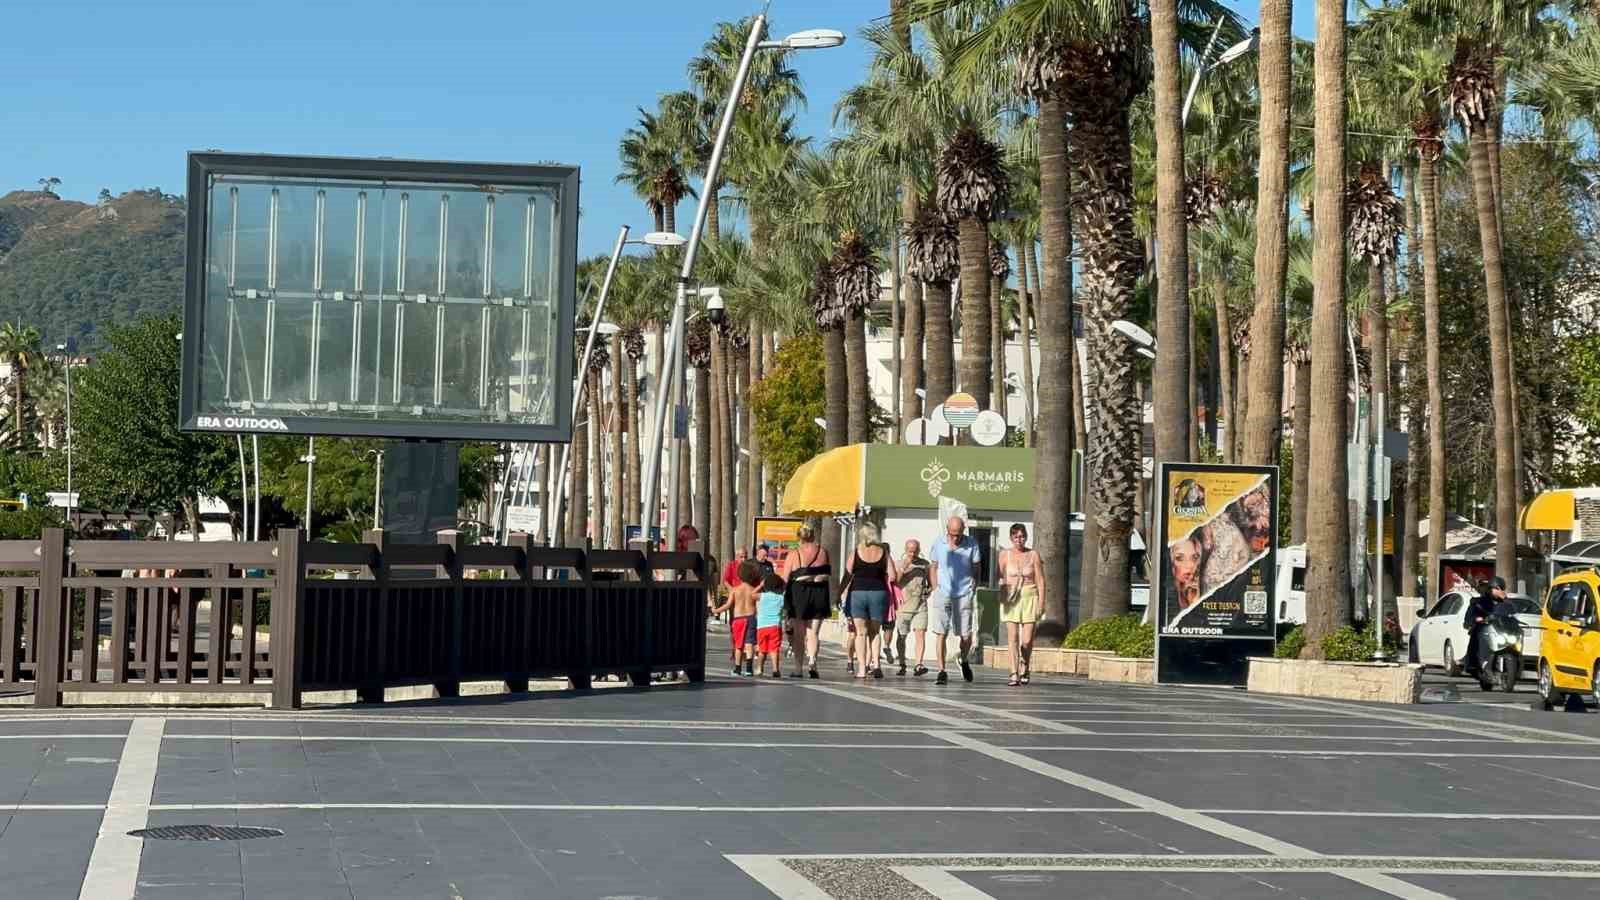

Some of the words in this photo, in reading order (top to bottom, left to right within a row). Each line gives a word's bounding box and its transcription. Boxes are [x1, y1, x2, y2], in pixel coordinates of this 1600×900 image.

[197, 416, 221, 427] ERA
[1162, 626, 1180, 635] ERA
[1181, 627, 1223, 635] OUTDOOR
